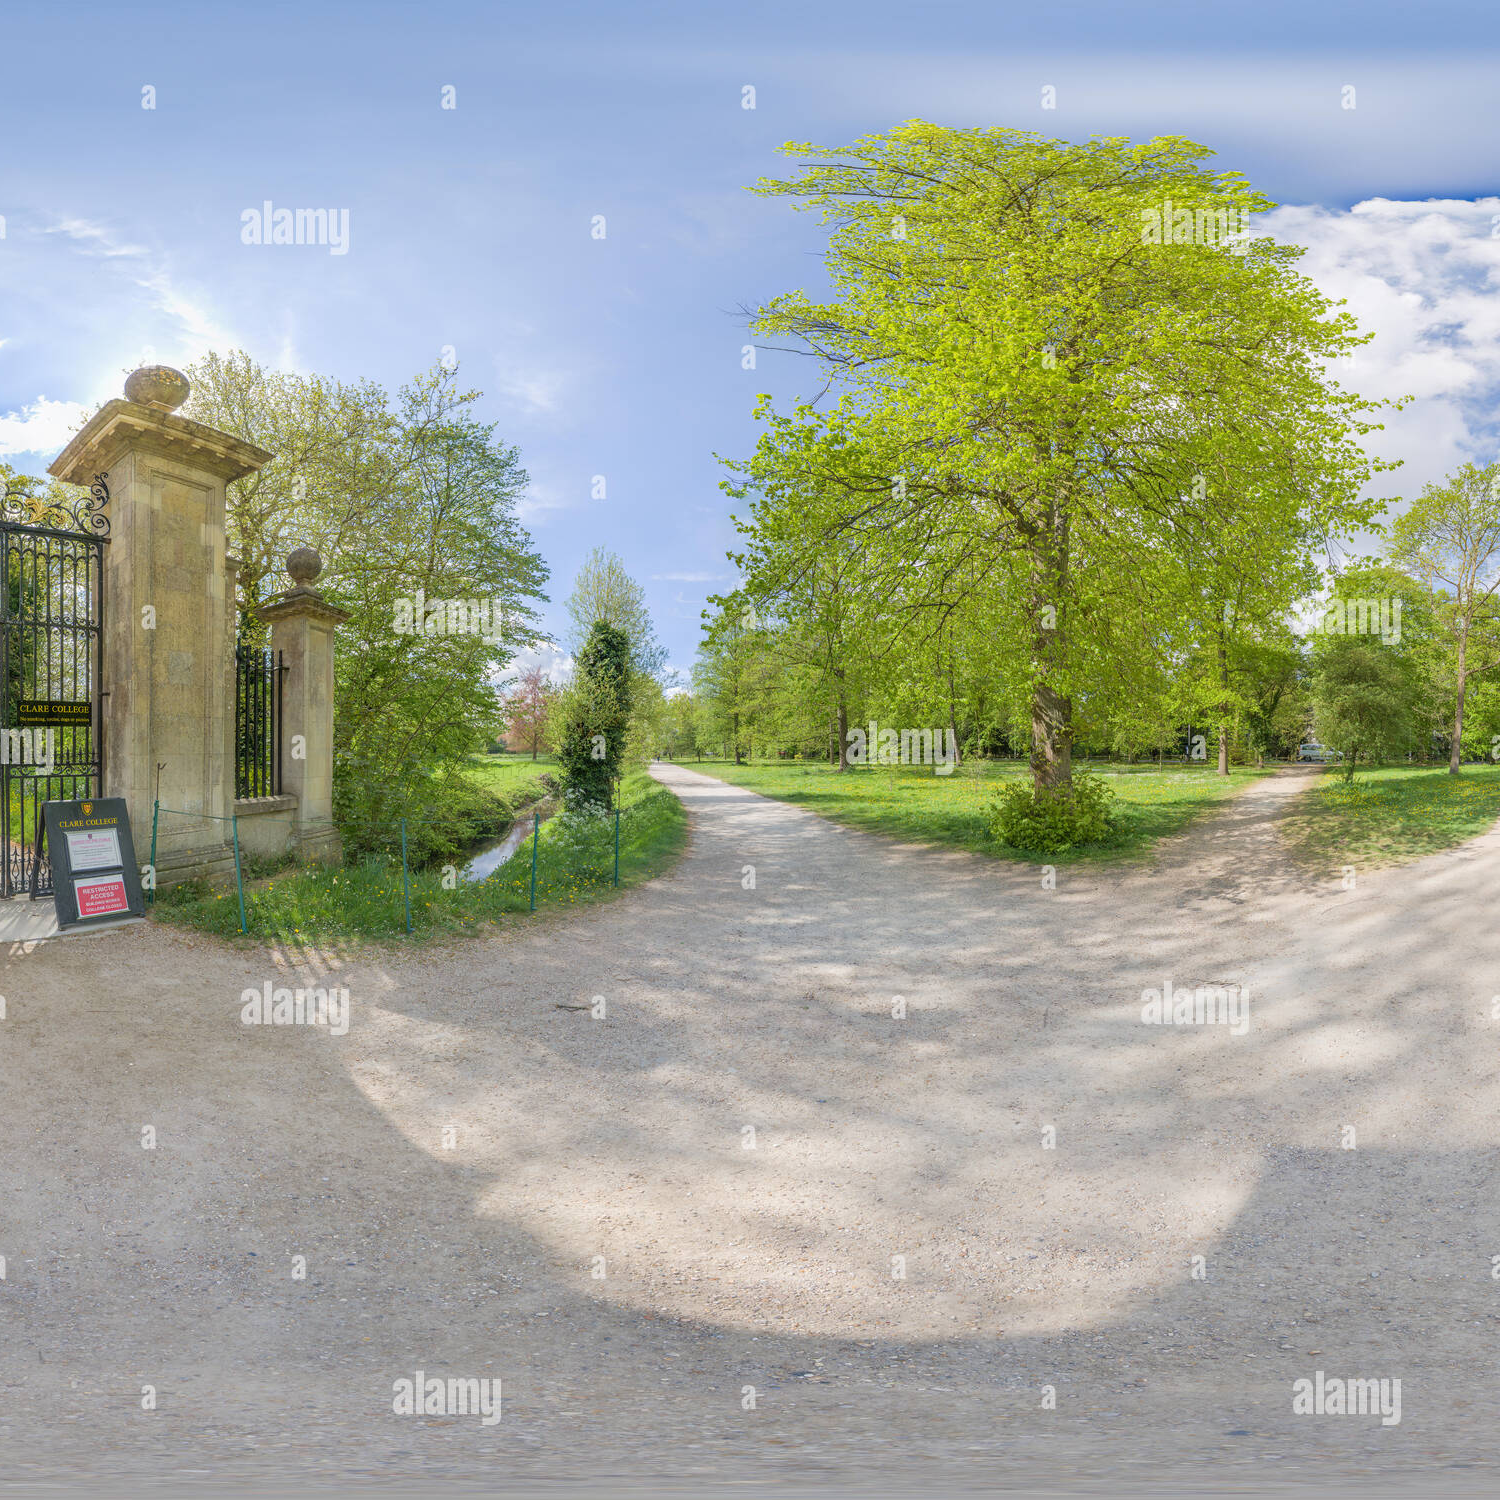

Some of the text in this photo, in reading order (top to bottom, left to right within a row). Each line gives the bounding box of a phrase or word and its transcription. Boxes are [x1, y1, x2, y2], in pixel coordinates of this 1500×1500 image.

[19, 705, 90, 713] CLARE COLLEGE
[85, 817, 118, 826] COLLEGE
[83, 885, 119, 894] RESTRICTED
